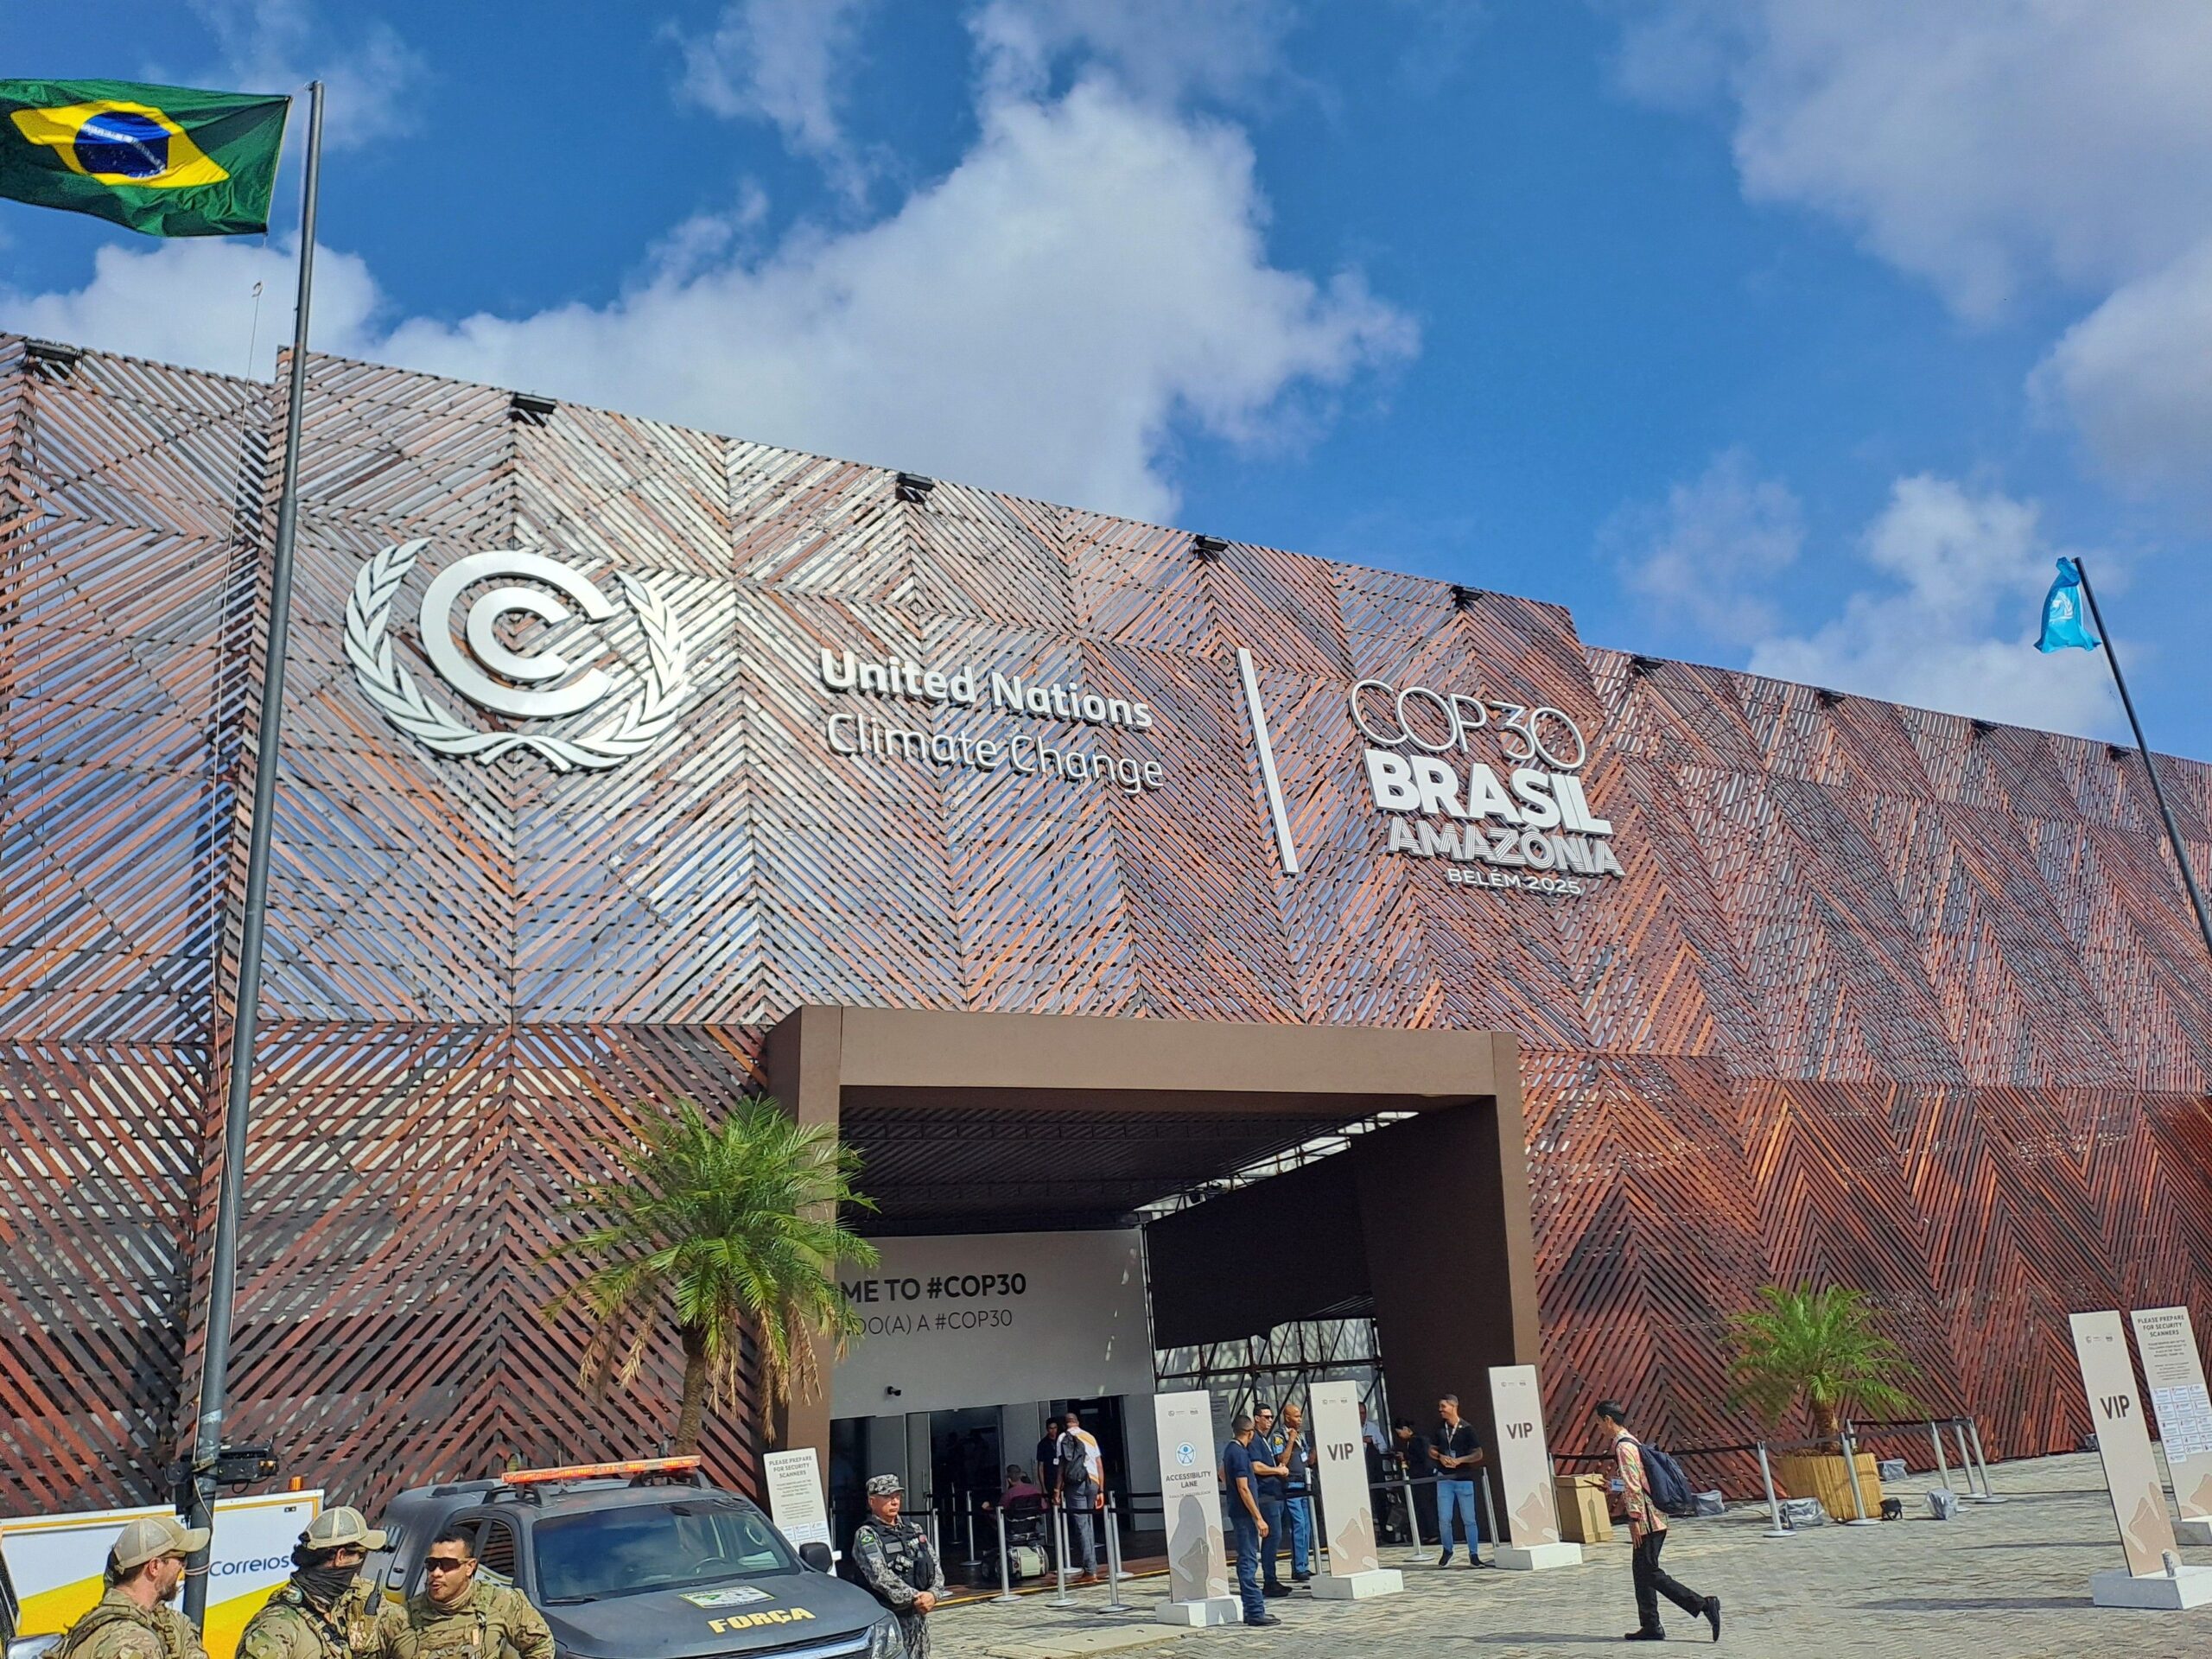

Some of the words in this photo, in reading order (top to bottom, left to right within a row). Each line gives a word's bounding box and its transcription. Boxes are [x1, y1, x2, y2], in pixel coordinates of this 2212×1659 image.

[822, 648, 976, 704] United
[991, 671, 1154, 729] Nations
[827, 713, 999, 769] Climate
[1009, 734, 1164, 796] Change
[1364, 748, 1613, 836] BRASIL
[1389, 817, 1626, 877] AMAZÔNIA
[1446, 868, 1522, 891] BELÉM
[1524, 875, 1581, 895] 2025
[884, 1278, 920, 1301] TO
[927, 1273, 1027, 1299] #COP30
[917, 1314, 930, 1332] A
[935, 1309, 1013, 1330] #COP30
[2100, 1395, 2130, 1420] VIP
[1506, 1422, 1533, 1440] VIP
[1327, 1442, 1354, 1461] VIP
[1166, 1471, 1211, 1482] ACCESSIBILITY
[1180, 1480, 1198, 1489] LANE
[209, 1555, 289, 1576] Correios
[708, 1607, 817, 1634] FORÇA
